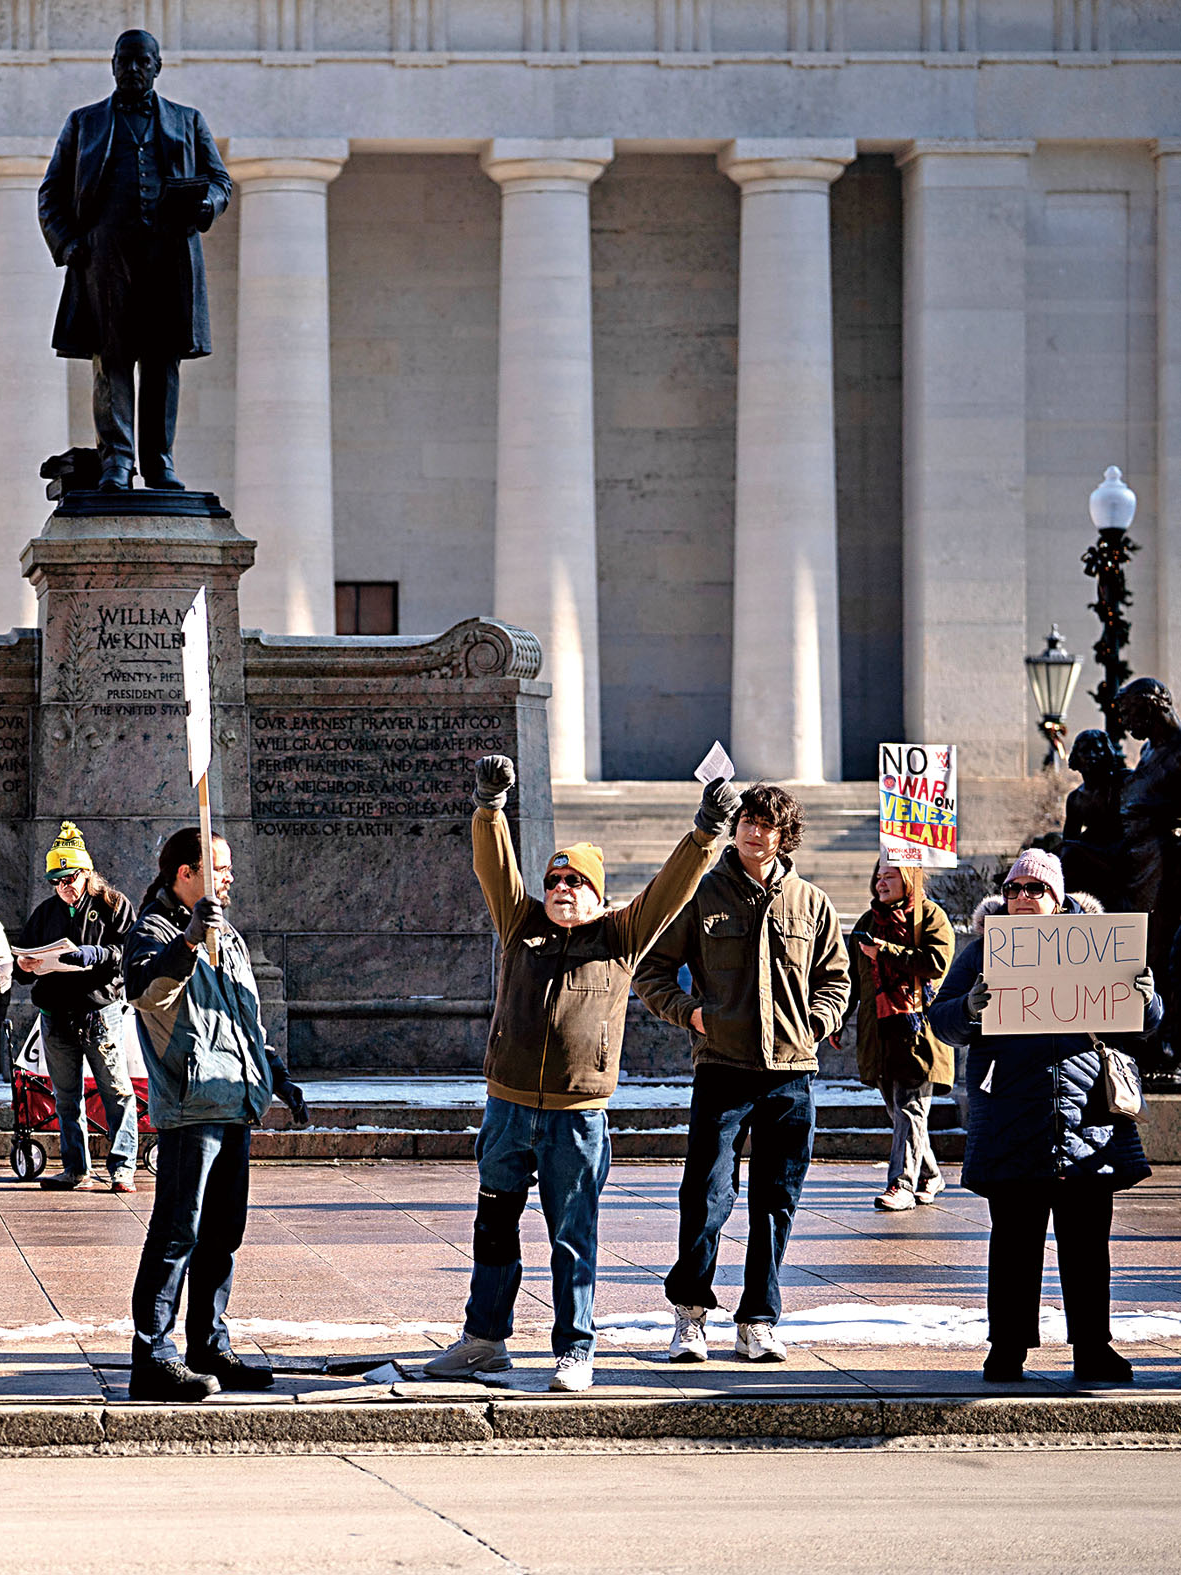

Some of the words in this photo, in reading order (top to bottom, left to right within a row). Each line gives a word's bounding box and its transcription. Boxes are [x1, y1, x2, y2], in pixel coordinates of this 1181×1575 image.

[107, 689, 165, 700] PRESIDENT
[168, 689, 183, 700] OF
[92, 704, 112, 716] THE
[293, 716, 357, 730] EARNEST
[361, 717, 416, 730] PRAYER
[418, 717, 429, 731] IS
[431, 716, 468, 731] THAT
[469, 715, 502, 730] GOD
[254, 738, 291, 751] WILL
[380, 759, 413, 773] AND
[416, 759, 458, 773] PEACE
[882, 745, 928, 776] NO
[2, 780, 22, 793] OF
[380, 781, 414, 794] AND
[421, 780, 453, 794] LIKE
[897, 775, 948, 803] WAR
[256, 801, 291, 815] INGS
[293, 801, 315, 815] TO
[379, 801, 439, 815] PEOPLES
[440, 801, 475, 815] AND
[881, 791, 955, 825] VENEZ
[934, 797, 955, 811] ON
[255, 823, 317, 837] POWERS
[322, 823, 342, 837] OF
[988, 925, 1140, 968] REMOVE
[987, 982, 1131, 1025] TRUMP
